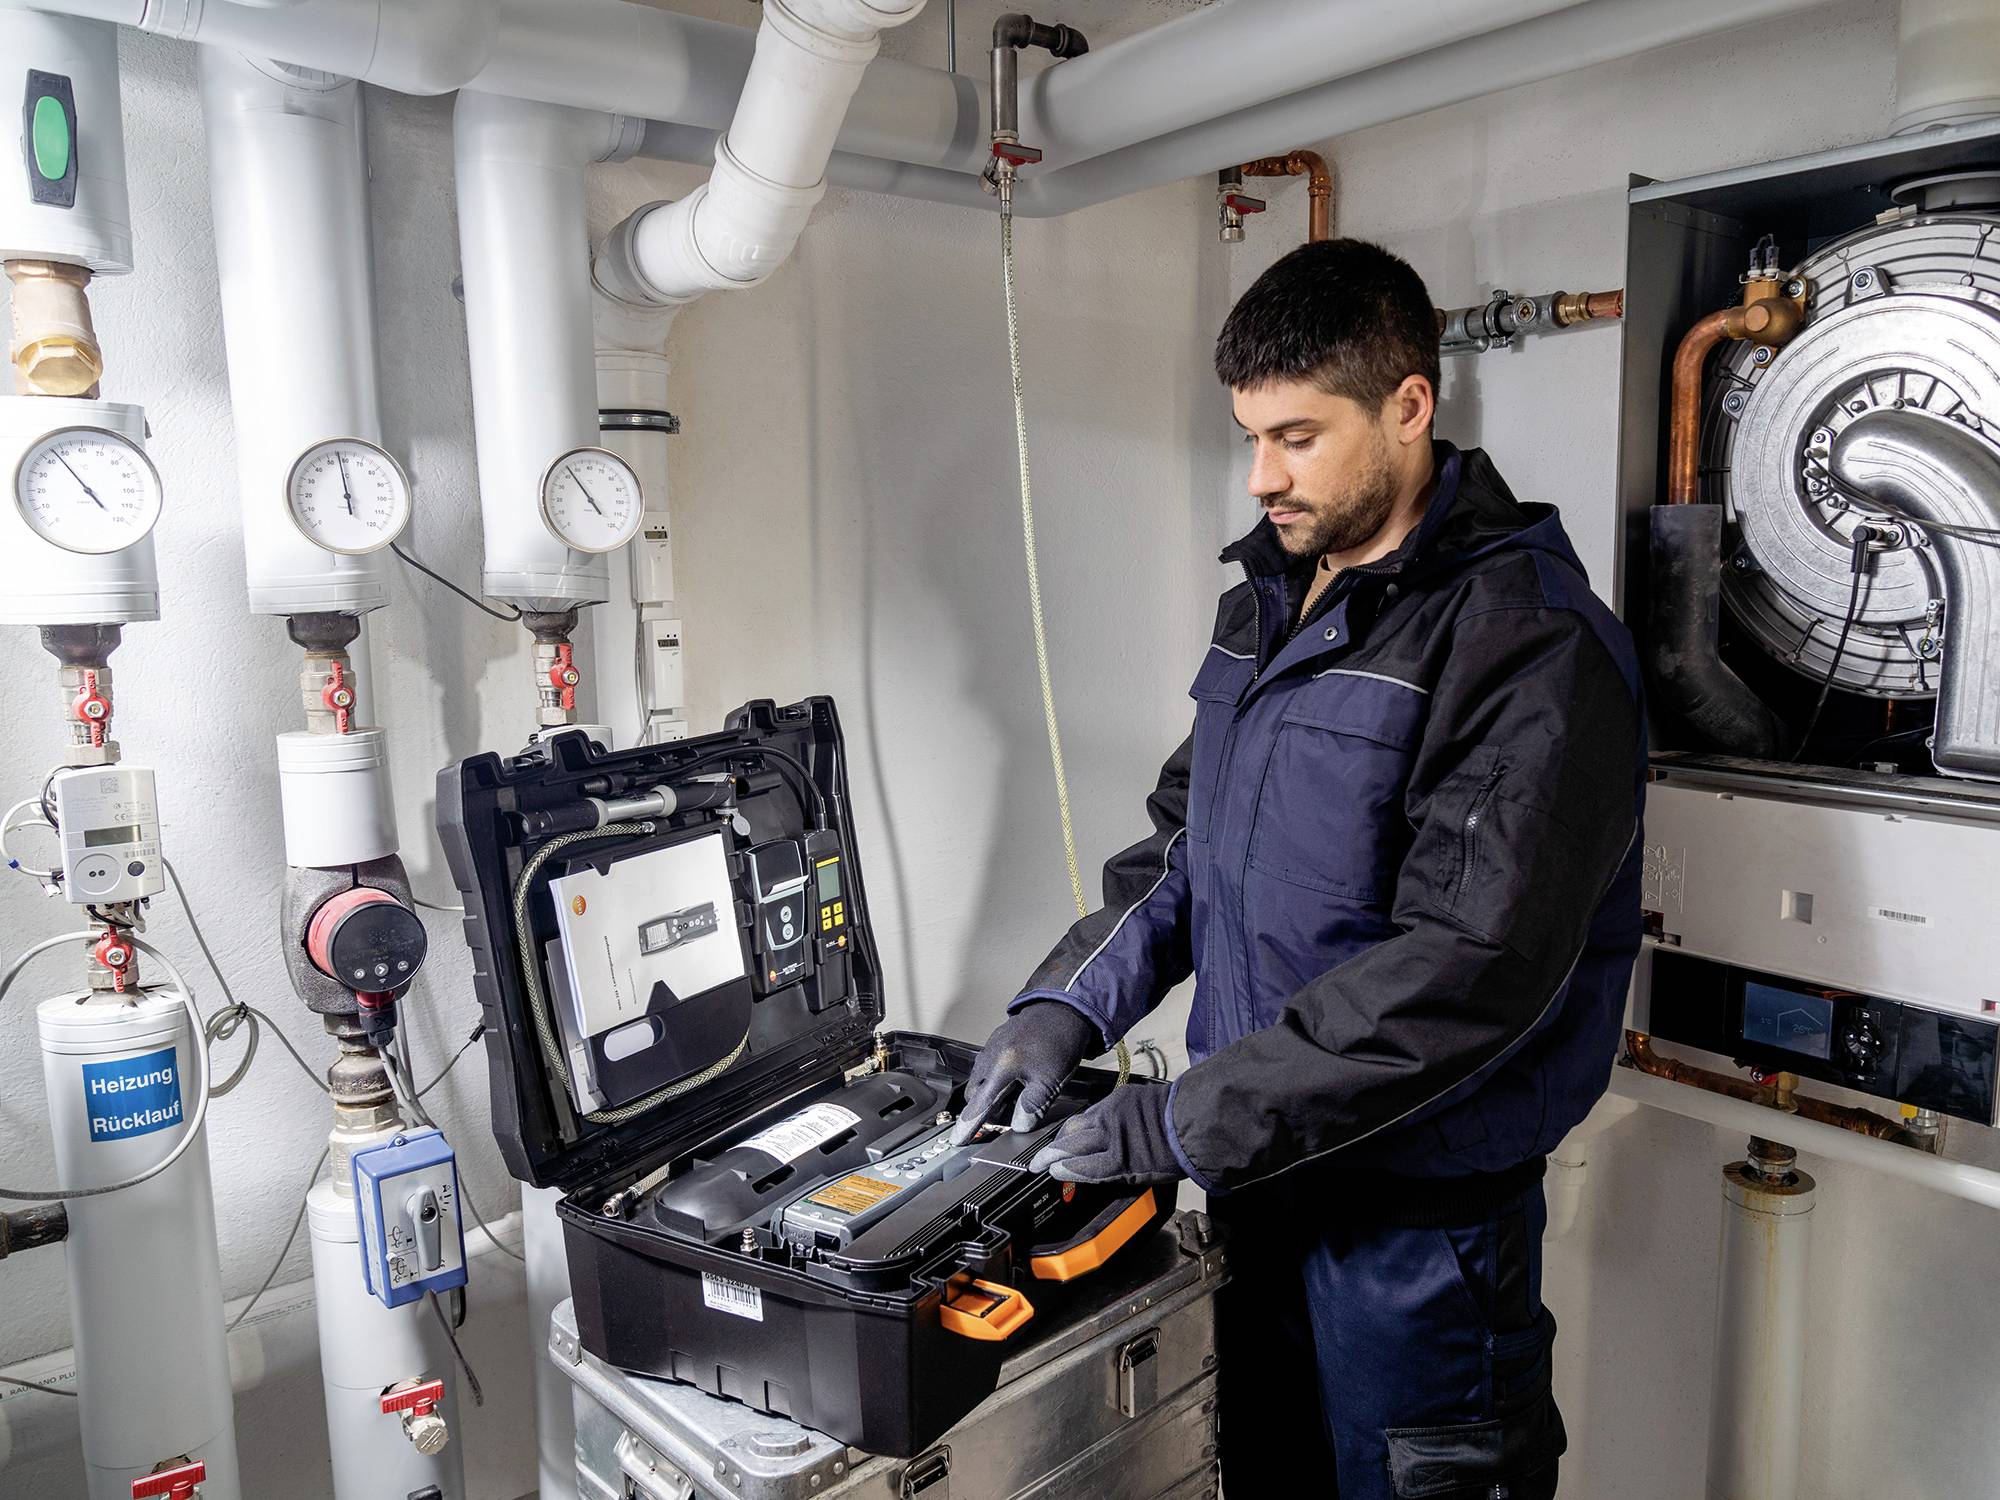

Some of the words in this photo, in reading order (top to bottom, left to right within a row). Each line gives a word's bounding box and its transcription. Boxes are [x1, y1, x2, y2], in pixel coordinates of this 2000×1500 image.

[91, 1067, 173, 1095] Heizung
[92, 1100, 180, 1134] Rücklauf
[10, 1377, 56, 1395] RAUANO
